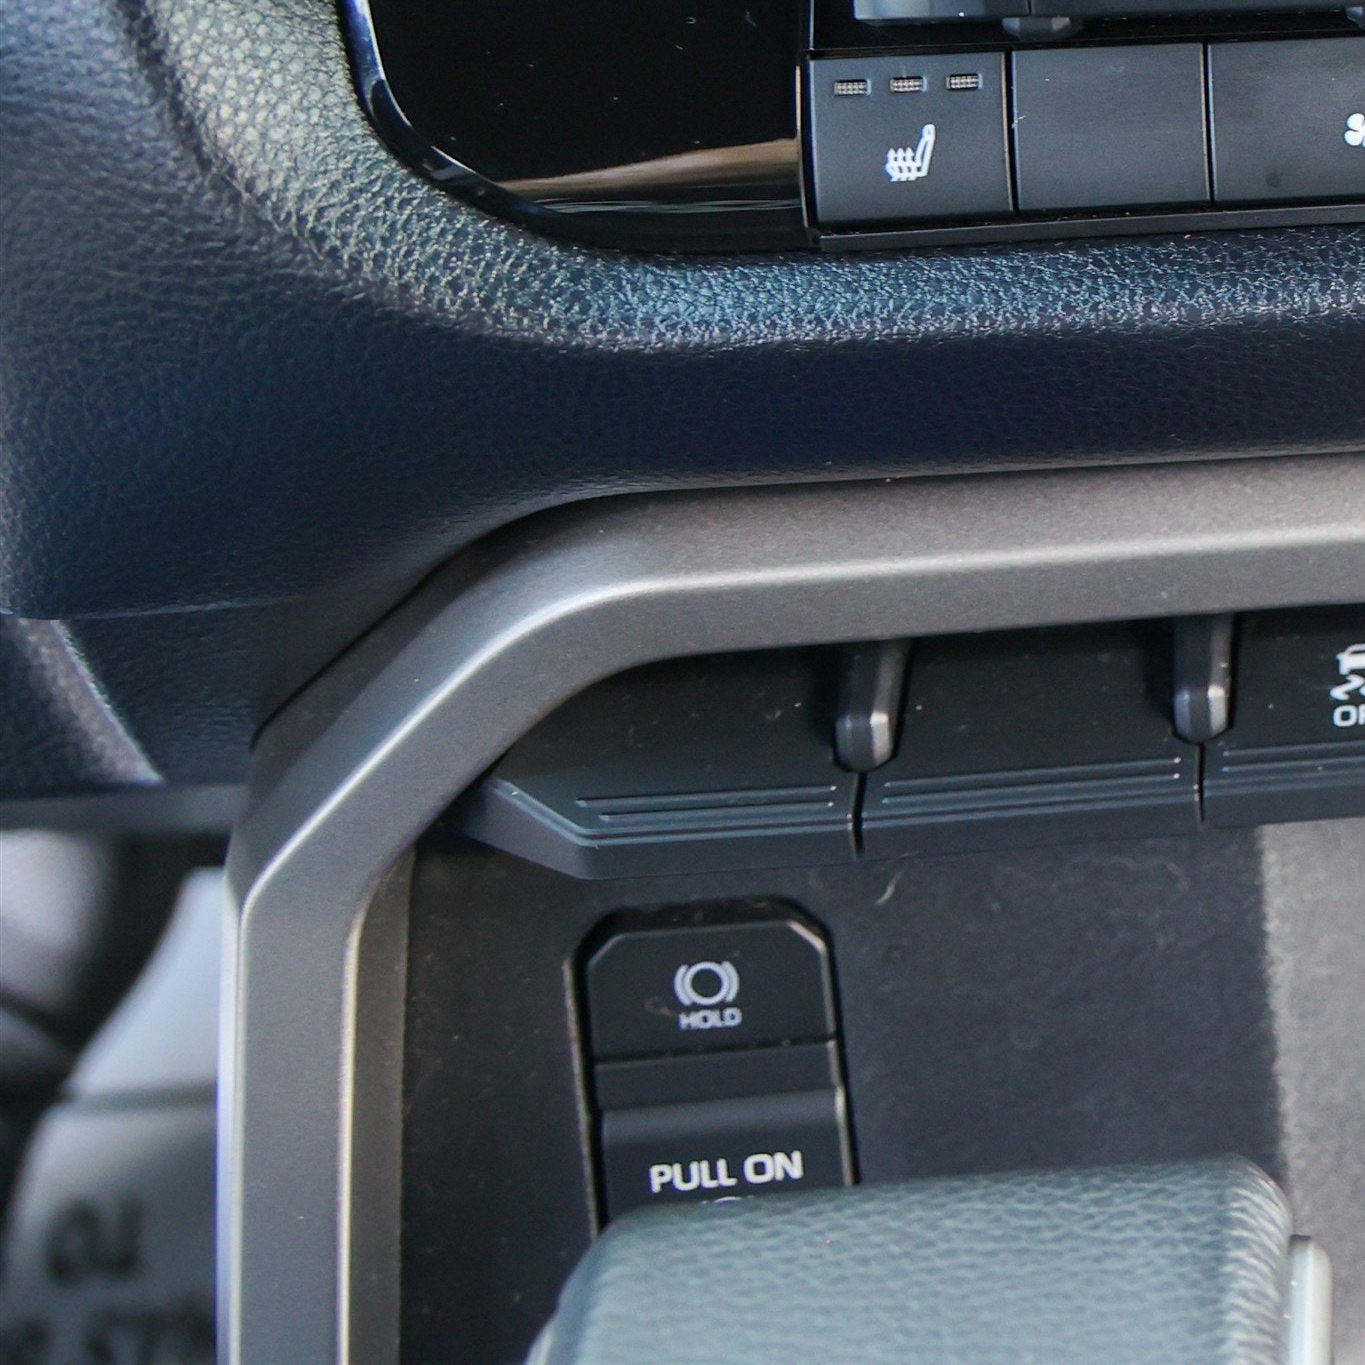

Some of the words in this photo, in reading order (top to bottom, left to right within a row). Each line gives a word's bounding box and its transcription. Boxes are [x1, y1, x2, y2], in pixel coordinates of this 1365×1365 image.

[680, 1008, 741, 1028] HOLD
[650, 1159, 737, 1192] PULL
[744, 1151, 802, 1183] ON
